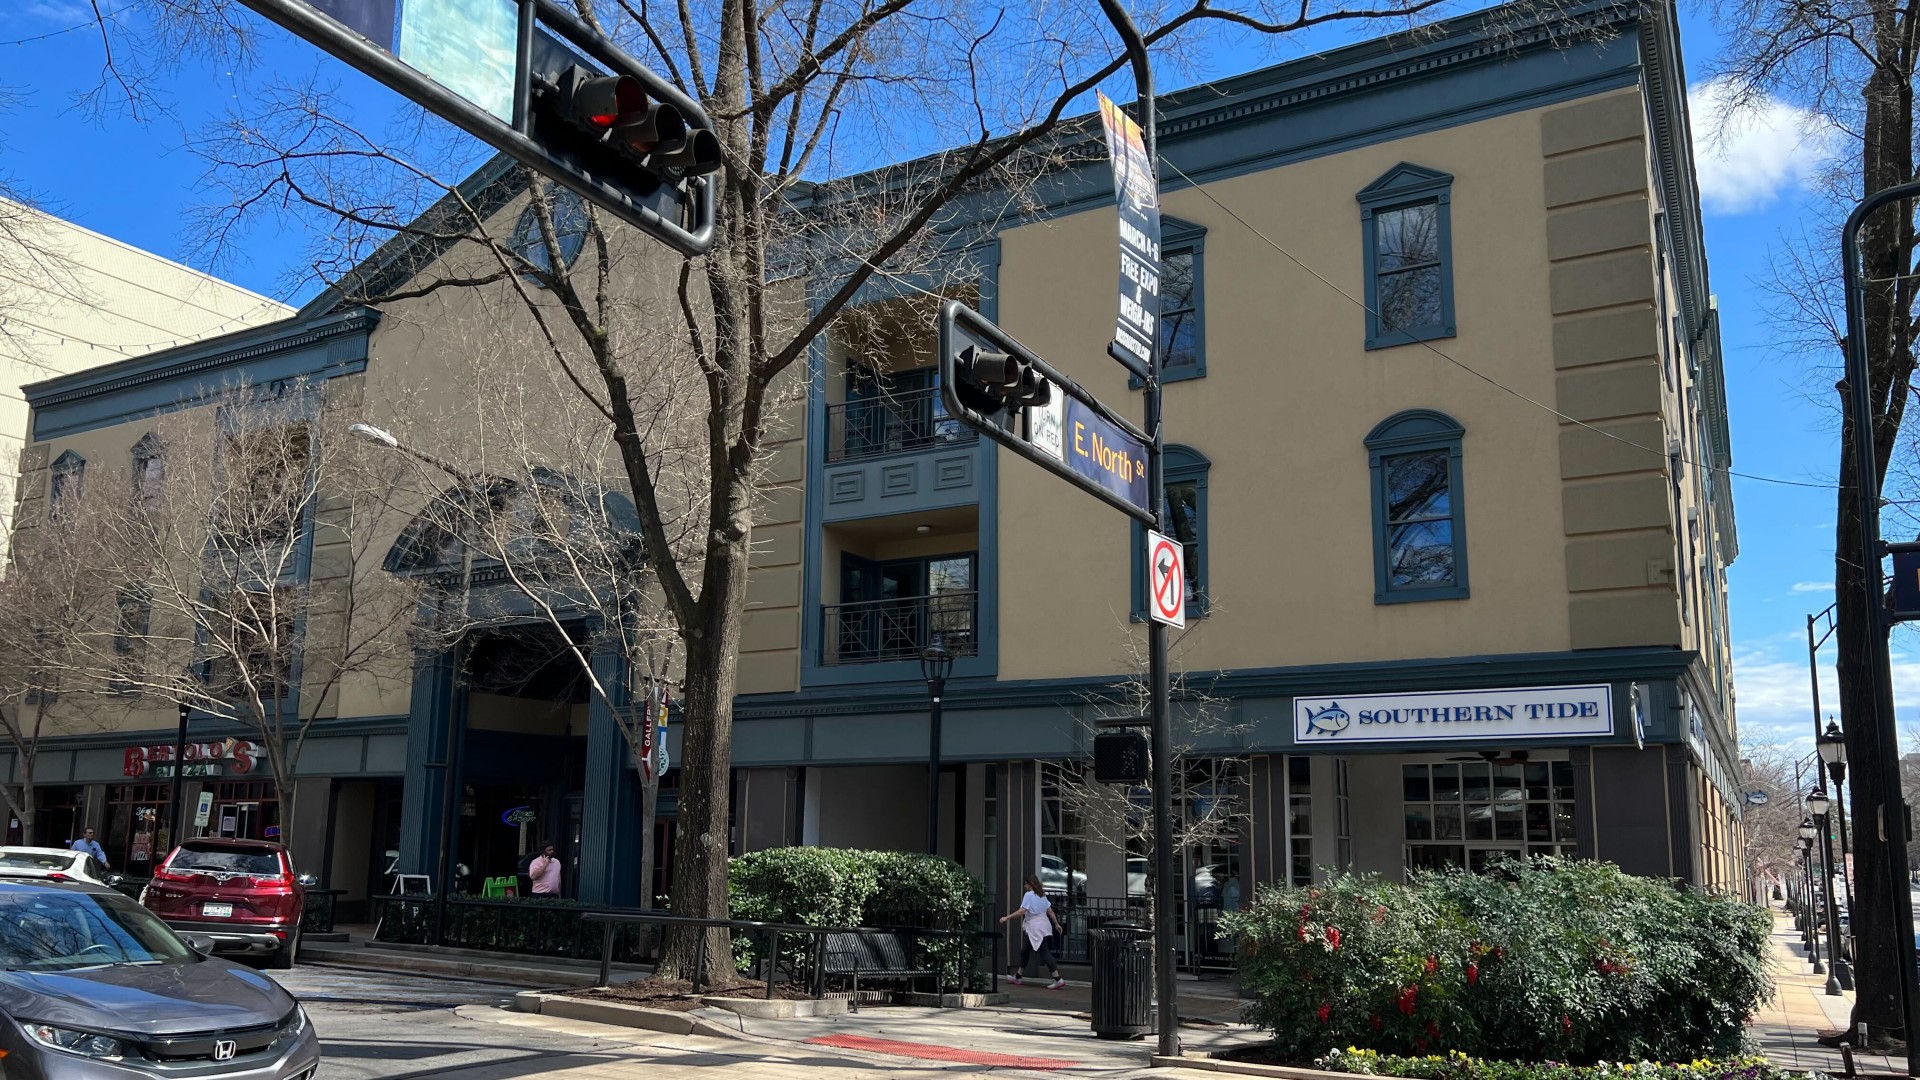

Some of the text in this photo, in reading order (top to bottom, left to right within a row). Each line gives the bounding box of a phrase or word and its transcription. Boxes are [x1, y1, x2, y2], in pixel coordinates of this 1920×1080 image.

[1119, 217, 1159, 262] MARCH 4-6
[1121, 253, 1158, 296] FREE EXPO
[1135, 285, 1142, 304] &
[1120, 293, 1155, 336] WEIGH-INS
[1033, 422, 1060, 448] ON RED
[1075, 421, 1145, 483] E. North St
[1359, 701, 1599, 725] SOUTHERN TIDE
[124, 738, 256, 776] BEROLO'S
[155, 764, 208, 776] PIZA
